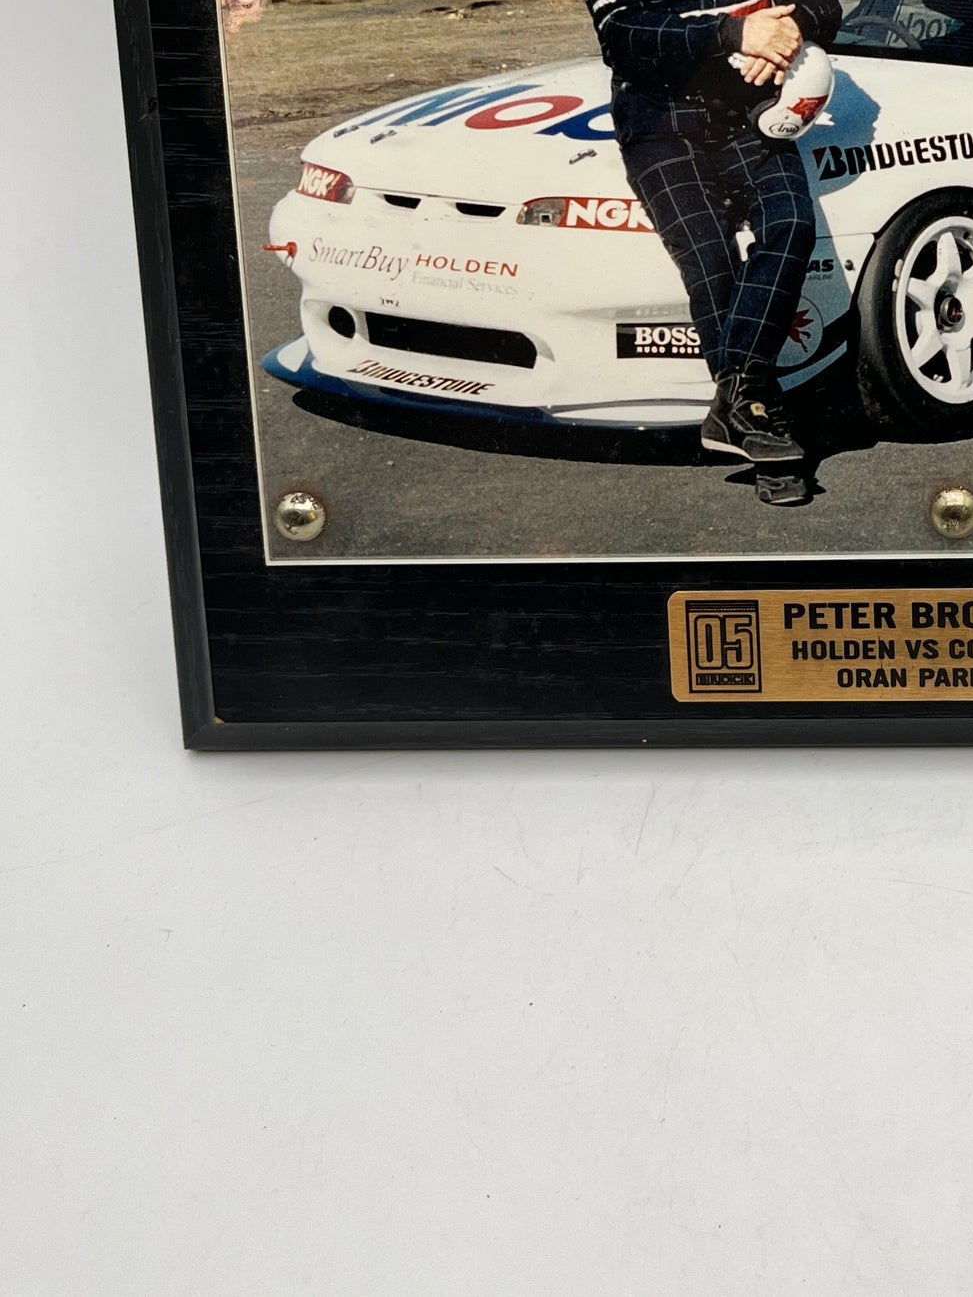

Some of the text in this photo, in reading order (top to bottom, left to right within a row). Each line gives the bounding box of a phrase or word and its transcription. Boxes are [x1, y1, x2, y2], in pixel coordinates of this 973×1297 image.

[308, 237, 518, 281] SmartBuy HOLDEN
[411, 271, 518, 296] Financial Services
[634, 326, 701, 346] BOSS
[346, 359, 495, 395] BRIDGESTONE
[784, 603, 896, 630] PETER
[694, 614, 754, 670] 05
[792, 640, 895, 660] HOLDEN
[905, 639, 939, 660] VS
[696, 672, 755, 686] BROCK
[837, 668, 907, 688] ORAN
